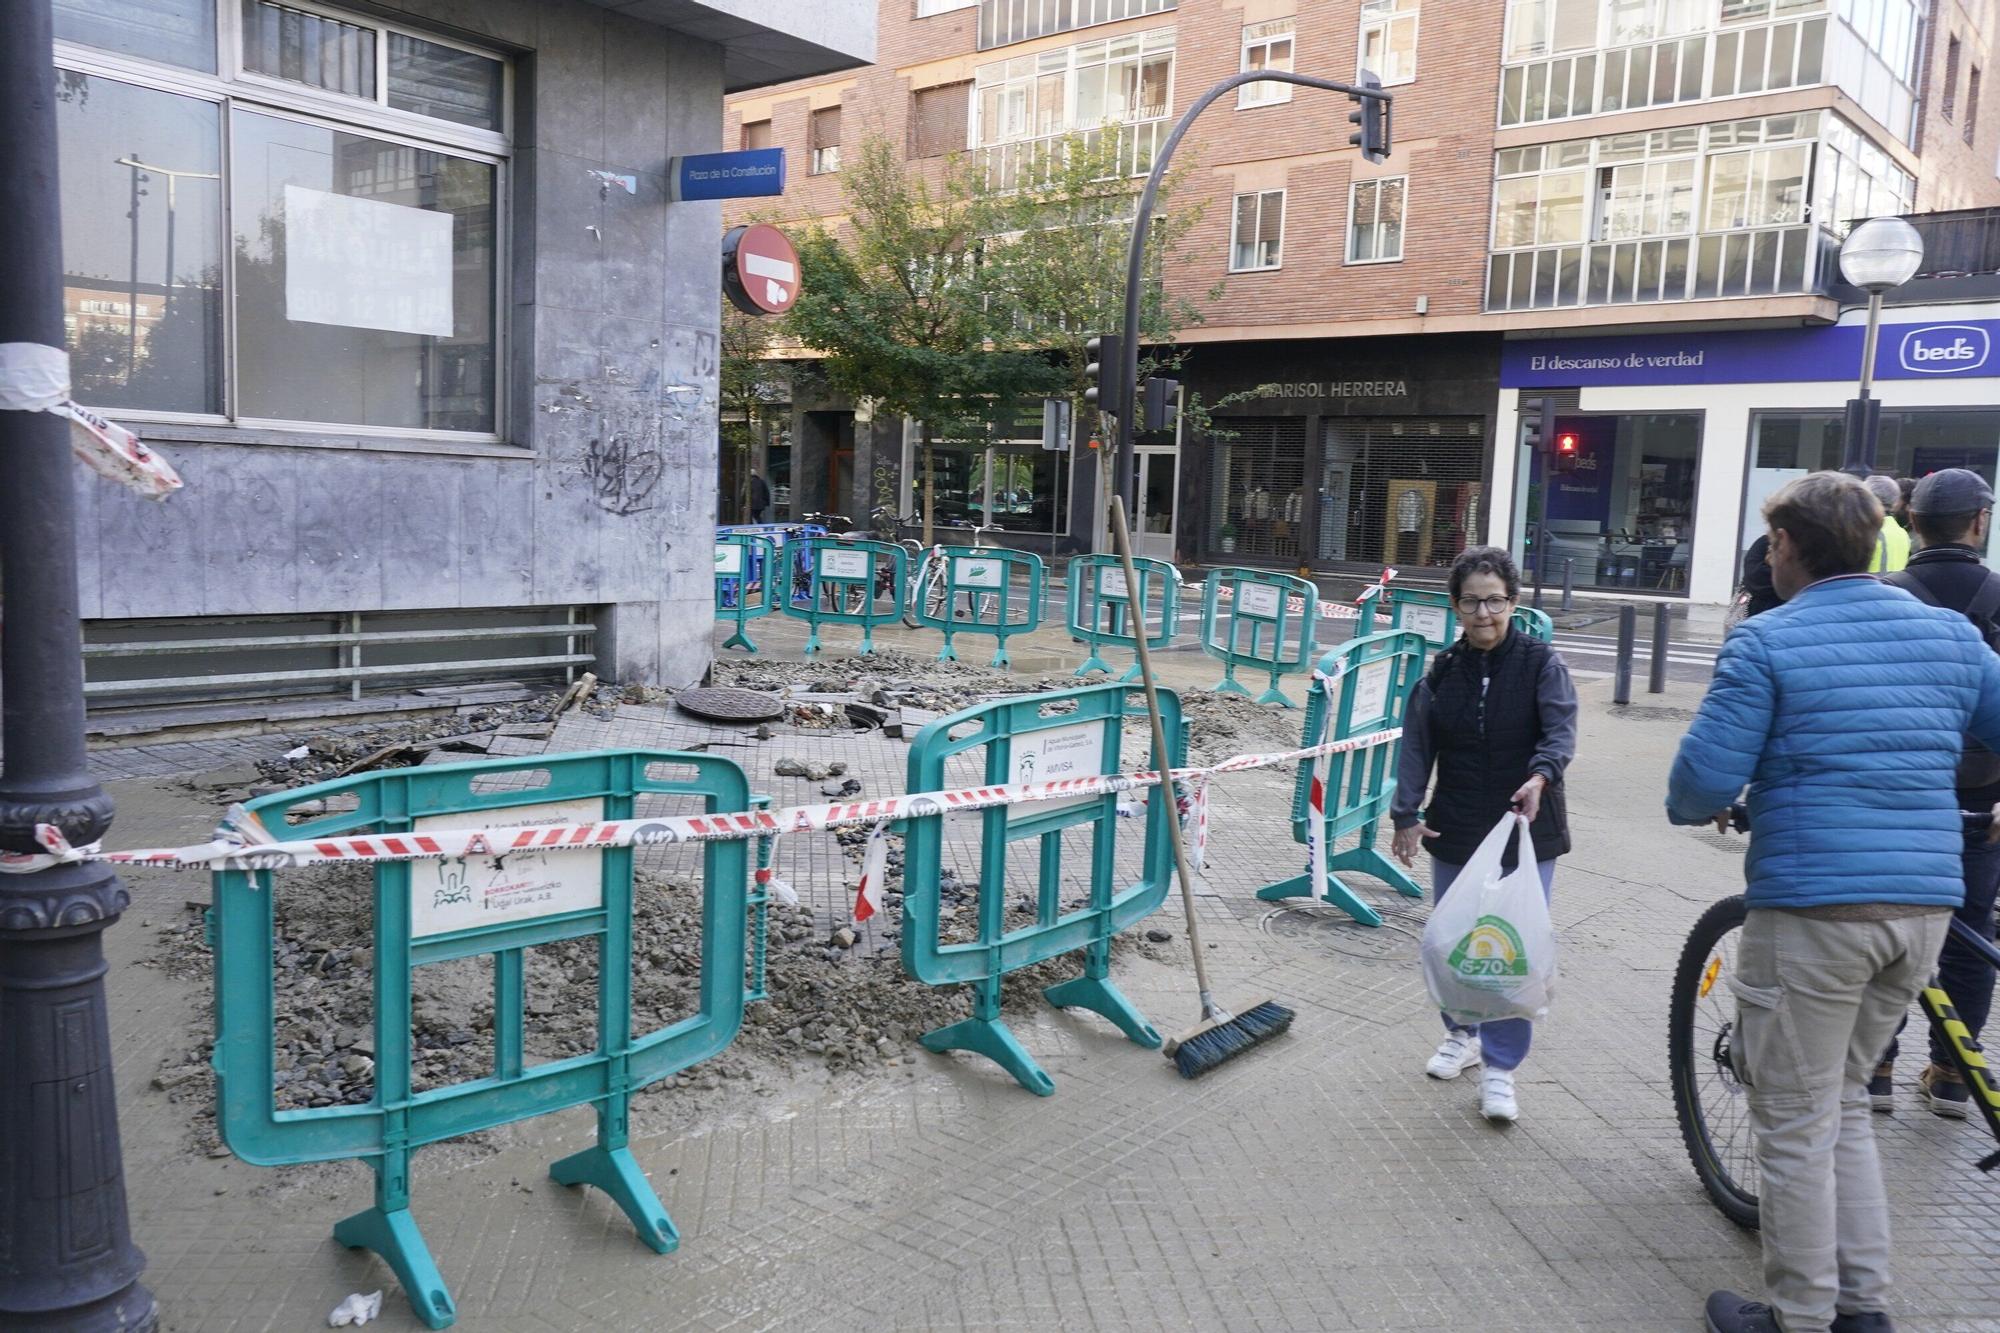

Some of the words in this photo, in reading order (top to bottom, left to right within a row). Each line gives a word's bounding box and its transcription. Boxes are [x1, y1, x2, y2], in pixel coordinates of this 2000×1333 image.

[689, 170, 708, 180] Plaza
[710, 169, 720, 179] de
[722, 168, 730, 178] la
[731, 164, 777, 177] Constitución
[351, 202, 393, 234] SE
[1913, 338, 1975, 361] bed's
[1531, 355, 1546, 370] El
[1549, 355, 1621, 369] descanso
[1624, 353, 1644, 367] de
[1647, 350, 1704, 366] verdad
[1331, 380, 1407, 396] HERRERA
[1046, 760, 1073, 774] AMVISA
[250, 853, 290, 870] 112
